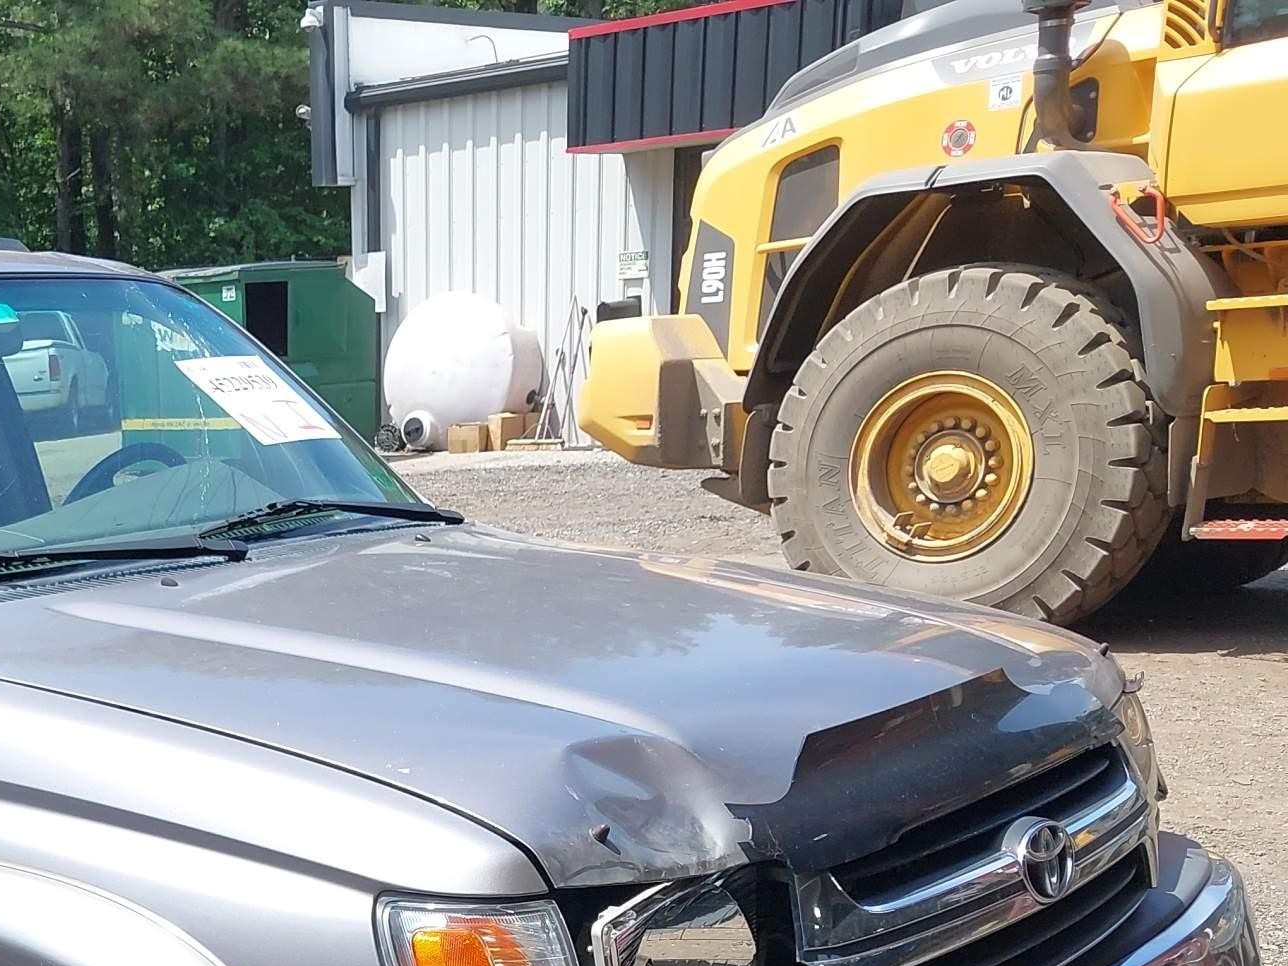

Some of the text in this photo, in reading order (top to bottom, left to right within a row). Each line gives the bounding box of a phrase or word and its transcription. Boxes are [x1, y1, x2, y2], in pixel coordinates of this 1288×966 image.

[951, 44, 1040, 74] VOLV
[700, 251, 727, 304] L90H
[816, 462, 888, 580] TITAN
